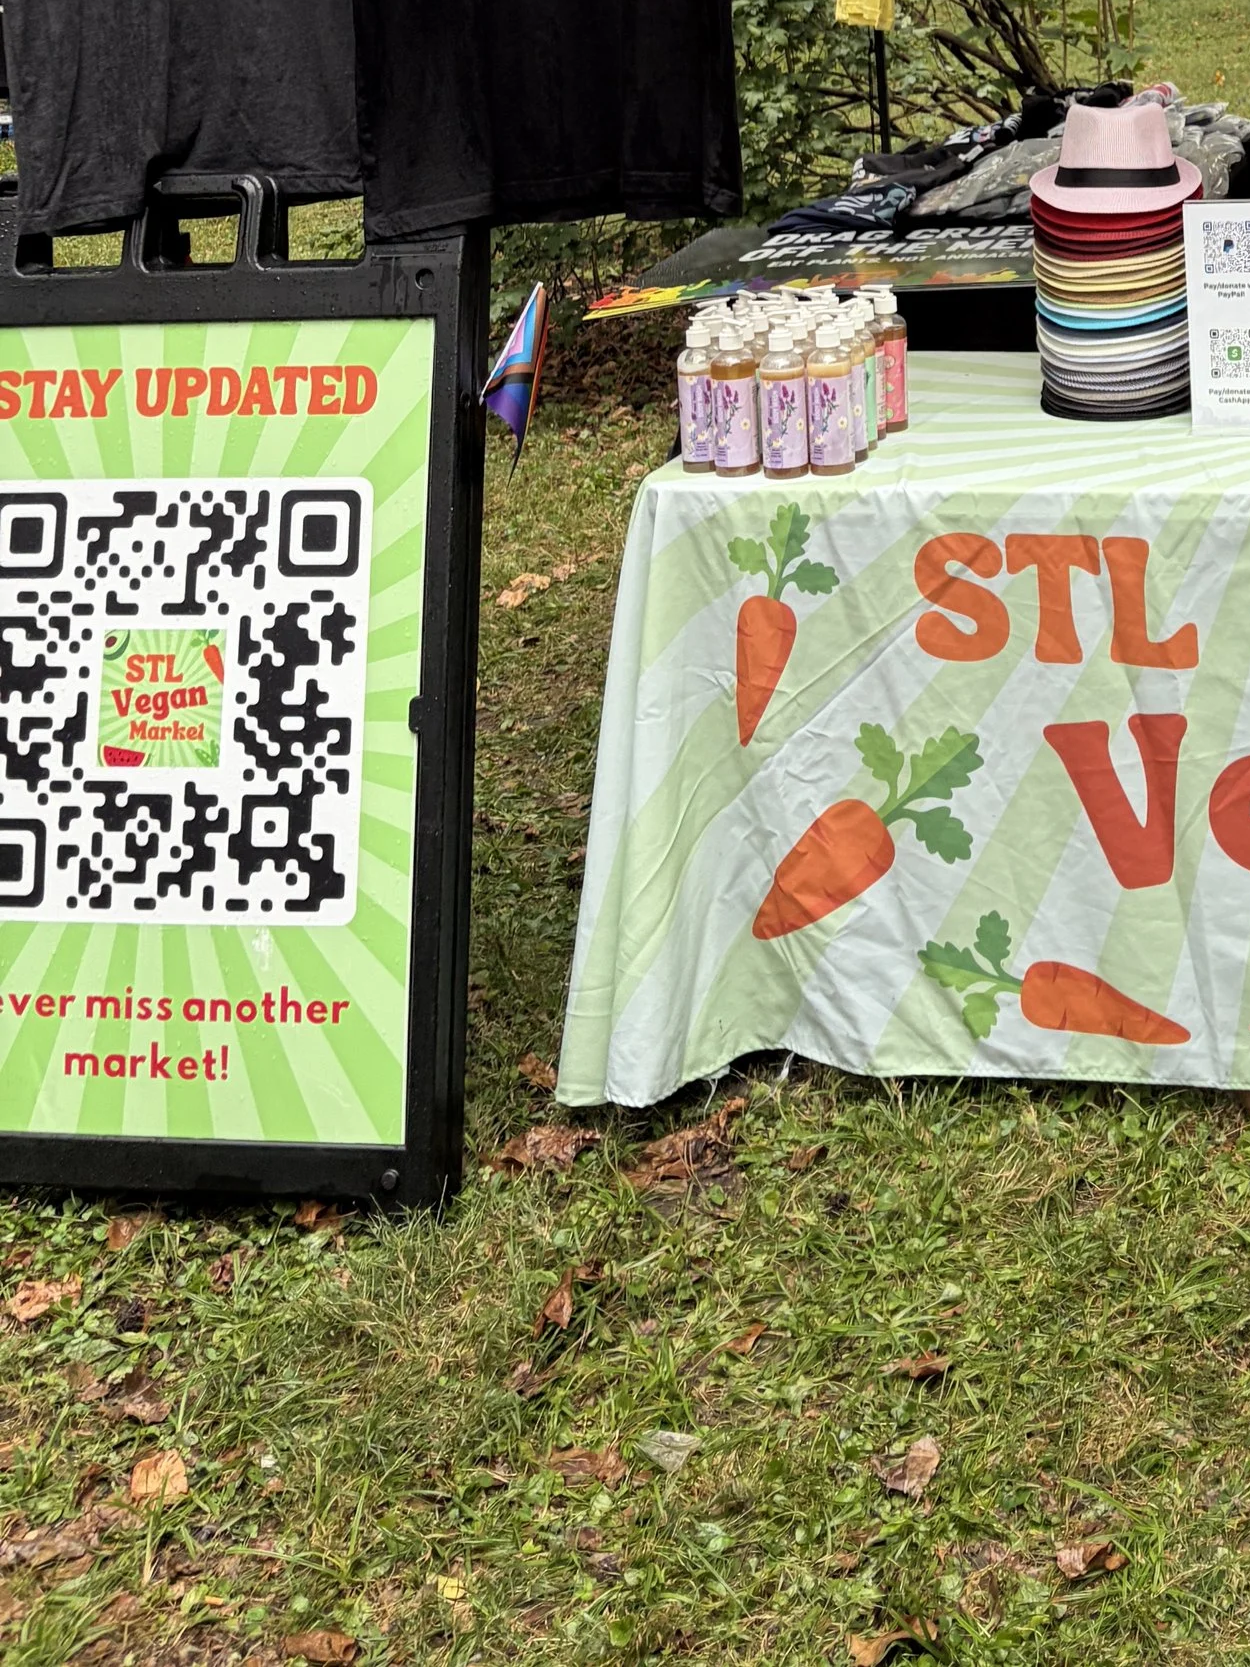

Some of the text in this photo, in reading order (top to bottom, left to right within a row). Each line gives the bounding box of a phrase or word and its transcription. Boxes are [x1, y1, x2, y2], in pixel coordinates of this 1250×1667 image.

[739, 245, 834, 262] OFF
[846, 241, 936, 256] THE
[761, 230, 893, 247] DRAG
[767, 260, 798, 268] EAT
[0, 366, 378, 419] STAY UPDATED
[913, 532, 1200, 670] STL
[125, 654, 183, 683] STL
[111, 685, 208, 721] Vegan
[129, 720, 205, 741] Market
[86, 986, 173, 1021] miss
[182, 986, 350, 1024] another
[64, 1041, 230, 1081] market!
